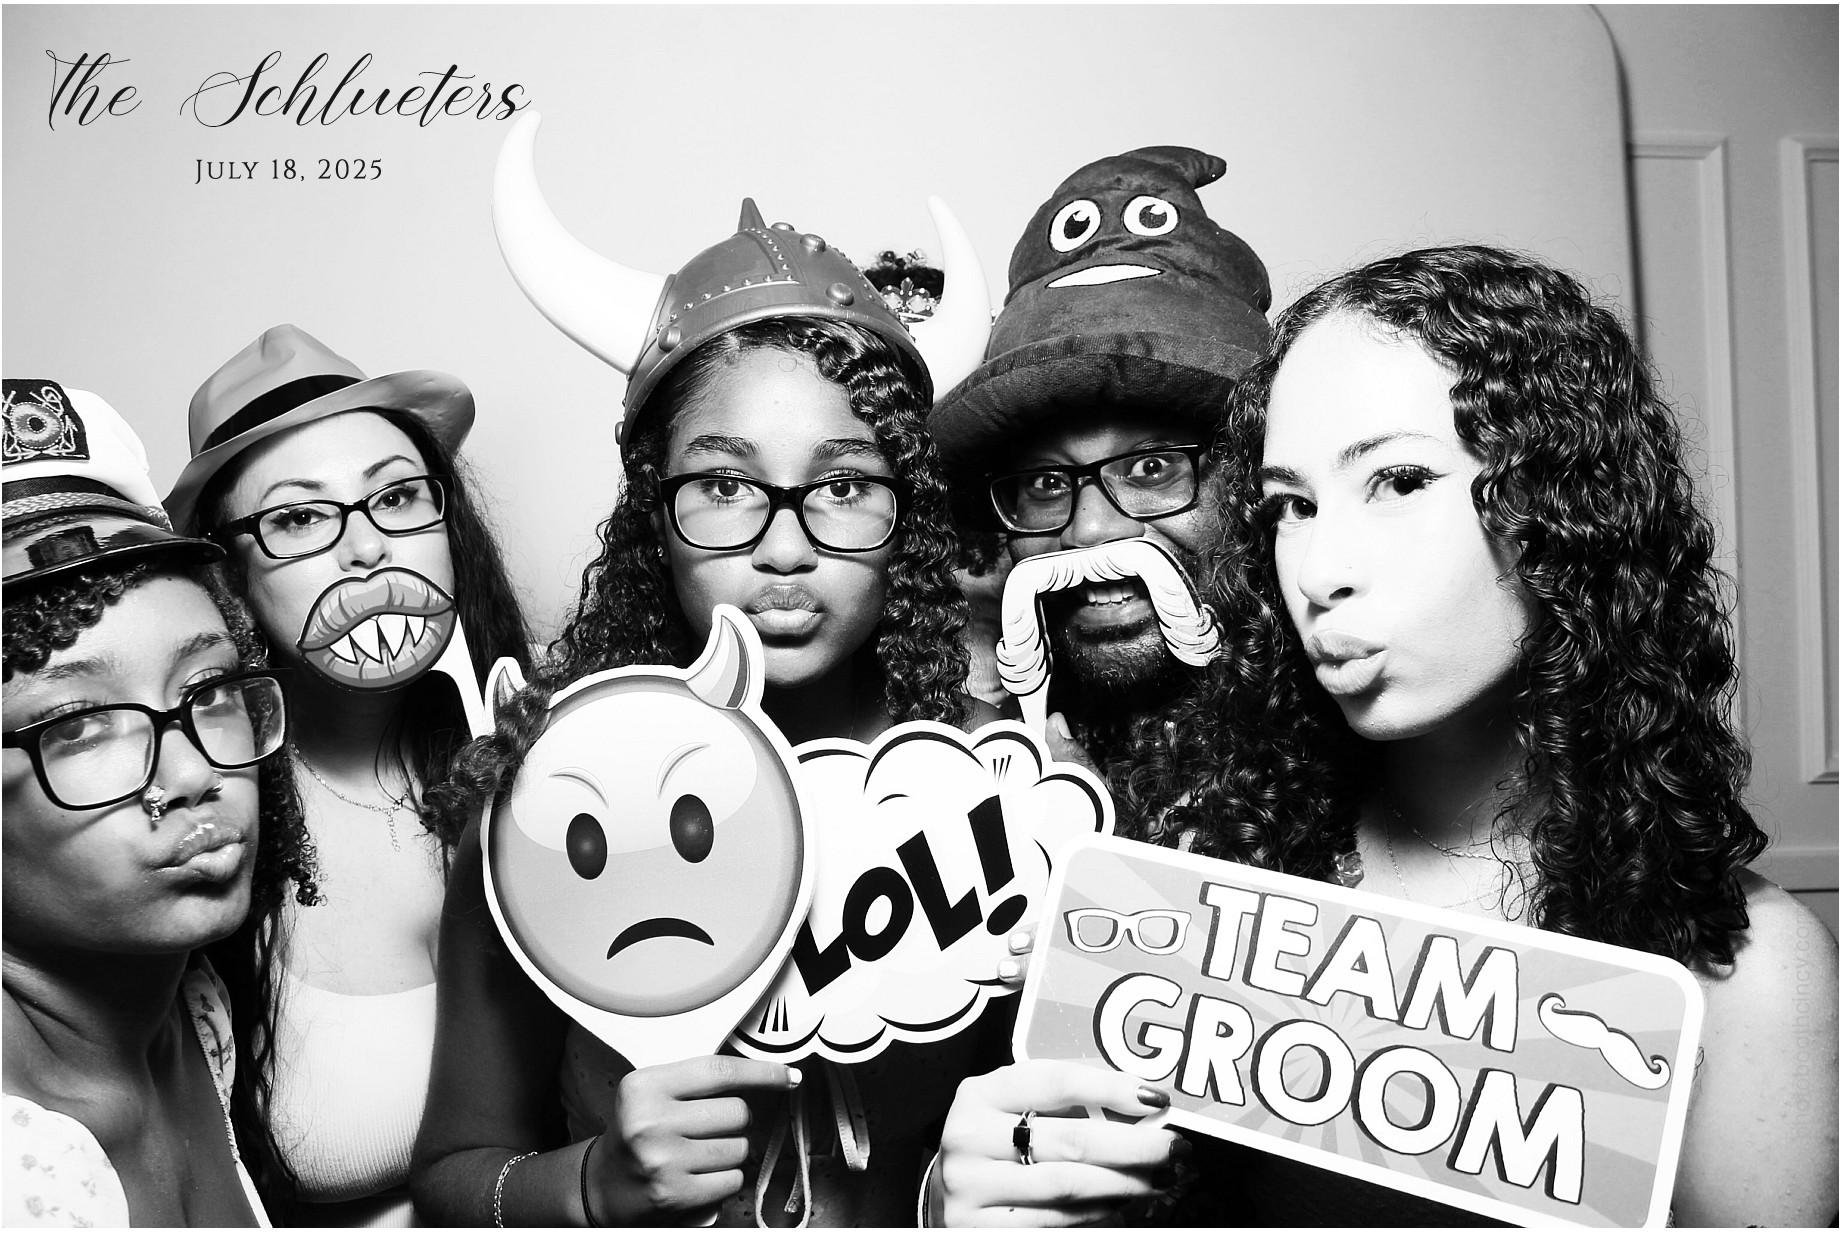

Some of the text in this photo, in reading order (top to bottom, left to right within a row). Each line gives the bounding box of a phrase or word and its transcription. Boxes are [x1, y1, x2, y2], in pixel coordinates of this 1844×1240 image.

[791, 794, 1028, 997] LOL!
[1201, 881, 1519, 1053] TEAM
[1093, 971, 1586, 1206] GROOM
